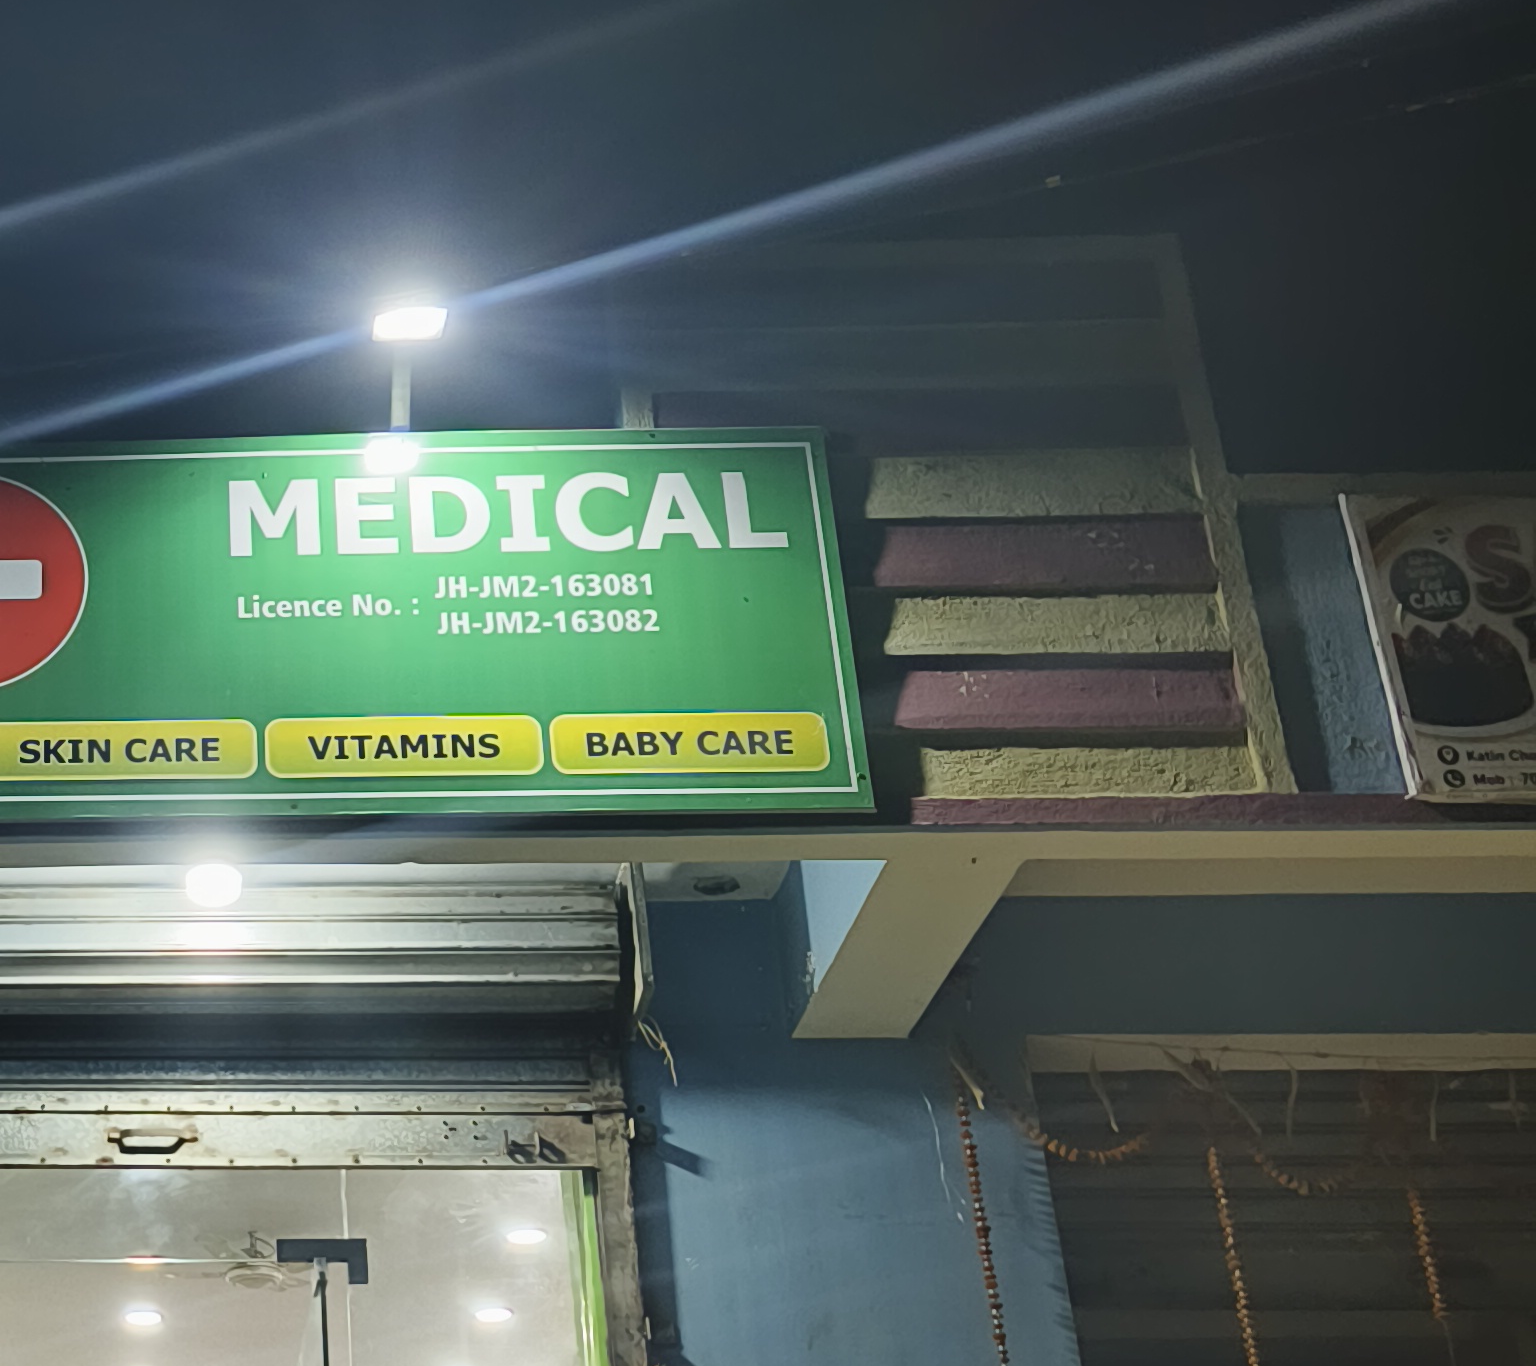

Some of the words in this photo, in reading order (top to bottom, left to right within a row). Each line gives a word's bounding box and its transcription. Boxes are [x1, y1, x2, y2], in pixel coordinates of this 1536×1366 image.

[227, 471, 789, 557] MEDICAL
[434, 573, 654, 600] JH-JM2-163081
[1409, 590, 1463, 610] CAKE
[237, 594, 343, 619] Licence
[351, 593, 402, 618] No.
[437, 608, 660, 636] JH-JM2-163082
[19, 738, 112, 764] SKIN
[125, 737, 221, 763] CARE
[307, 733, 501, 760] VITAMINS
[585, 731, 683, 757] BABY
[696, 729, 794, 756] CARE
